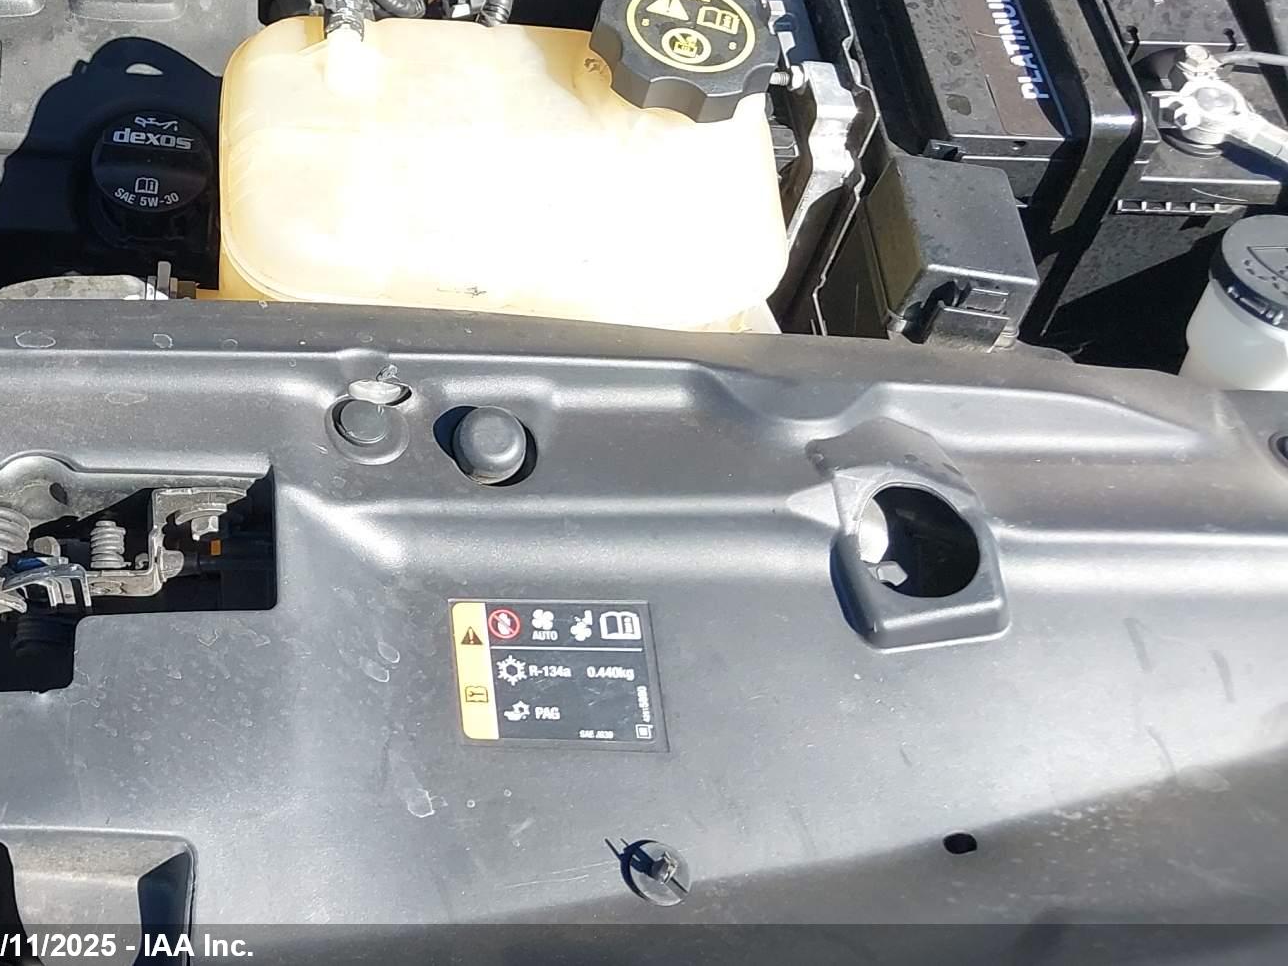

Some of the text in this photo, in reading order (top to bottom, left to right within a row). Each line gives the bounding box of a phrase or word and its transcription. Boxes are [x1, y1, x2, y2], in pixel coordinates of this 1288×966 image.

[113, 128, 194, 150] dexos
[114, 188, 179, 208] SAE 5W-30
[532, 630, 558, 641] AUTO
[529, 665, 634, 681] R-134a 0.440kg
[535, 707, 561, 720] PAG
